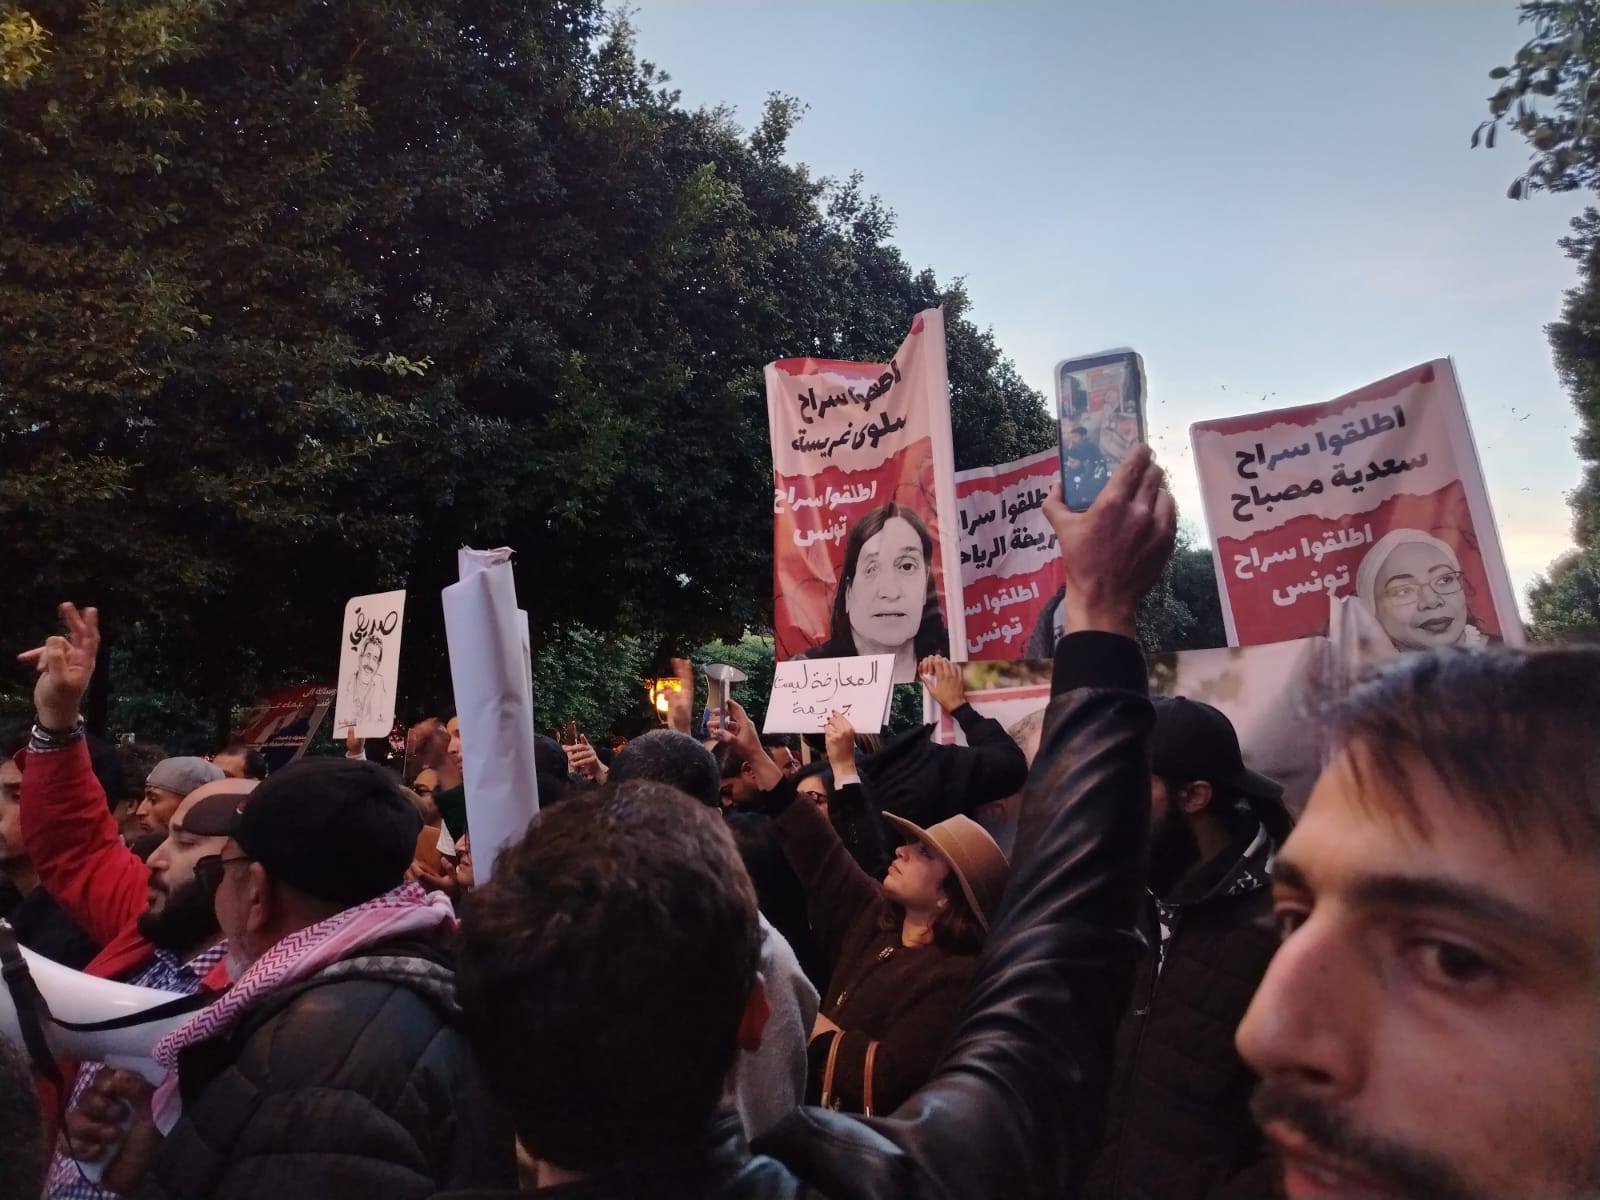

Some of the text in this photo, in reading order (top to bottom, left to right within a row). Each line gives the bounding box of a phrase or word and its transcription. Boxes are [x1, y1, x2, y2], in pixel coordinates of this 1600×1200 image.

[797, 387, 849, 424] سراح
[1235, 404, 1406, 479] اطلقوا سراح
[774, 480, 877, 514] اطلقوا سراح
[1231, 452, 1429, 522] سعدية مصباح
[793, 515, 847, 547] تونس
[960, 485, 1051, 536] طلقوا سرا
[960, 526, 1057, 570] ريفة الرياح
[1234, 523, 1373, 579] اطلقوا سراح
[983, 581, 1040, 615] اطلقوا
[1272, 565, 1351, 606] تونس
[349, 607, 398, 652] صديقي
[967, 616, 1023, 654] تونس
[811, 659, 878, 702] المعارضة
